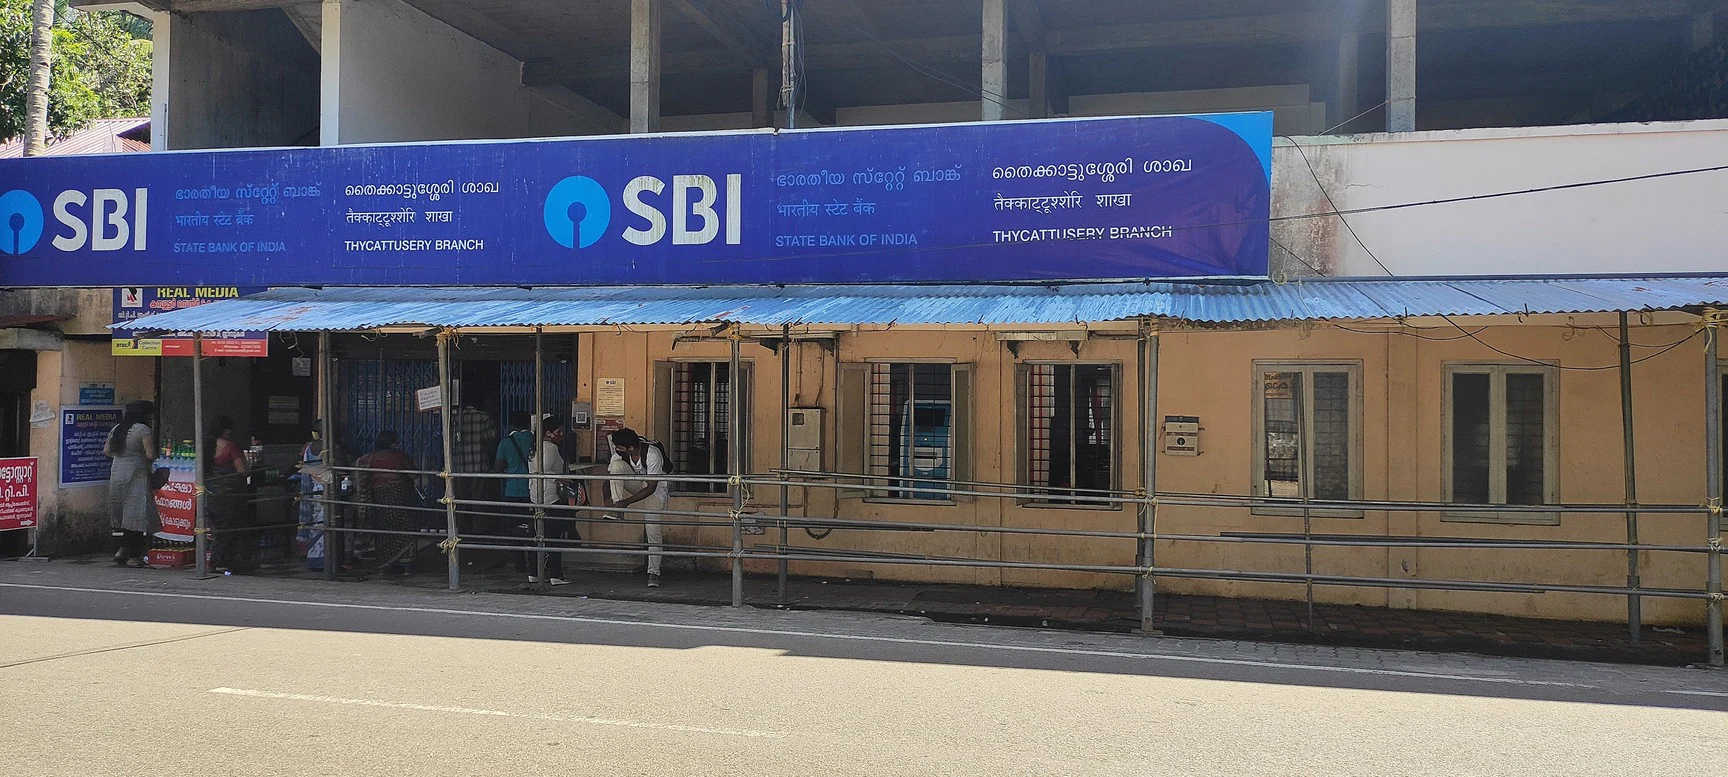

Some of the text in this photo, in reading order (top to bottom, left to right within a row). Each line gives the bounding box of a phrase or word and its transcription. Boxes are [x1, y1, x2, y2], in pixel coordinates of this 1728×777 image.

[1143, 158, 1193, 173] ശാഖ
[776, 171, 846, 187] ഭാരതീയ
[913, 163, 963, 184] ബാങ്ക്
[175, 188, 230, 200] ഭാരതീയ
[283, 182, 322, 198] ബാങ്ക്
[461, 182, 499, 194] ശാഖ
[776, 198, 877, 218] भारतीय स्टेट बैंक
[1095, 193, 1132, 208] शाखा
[425, 211, 454, 223] शाखा
[621, 173, 742, 246] SBI
[52, 187, 148, 252] SBI
[175, 211, 209, 227] भारतीय
[213, 211, 233, 226] स्टेट
[775, 233, 918, 247] STATE BANK OF INDIA
[992, 225, 1173, 243] THYCATTUSERY BRANCH
[173, 241, 287, 253] STATE BANK OF INDIA
[345, 239, 484, 251] THYCATTUSERY BRANCH
[76, 413, 117, 421] REAL MEDIA
